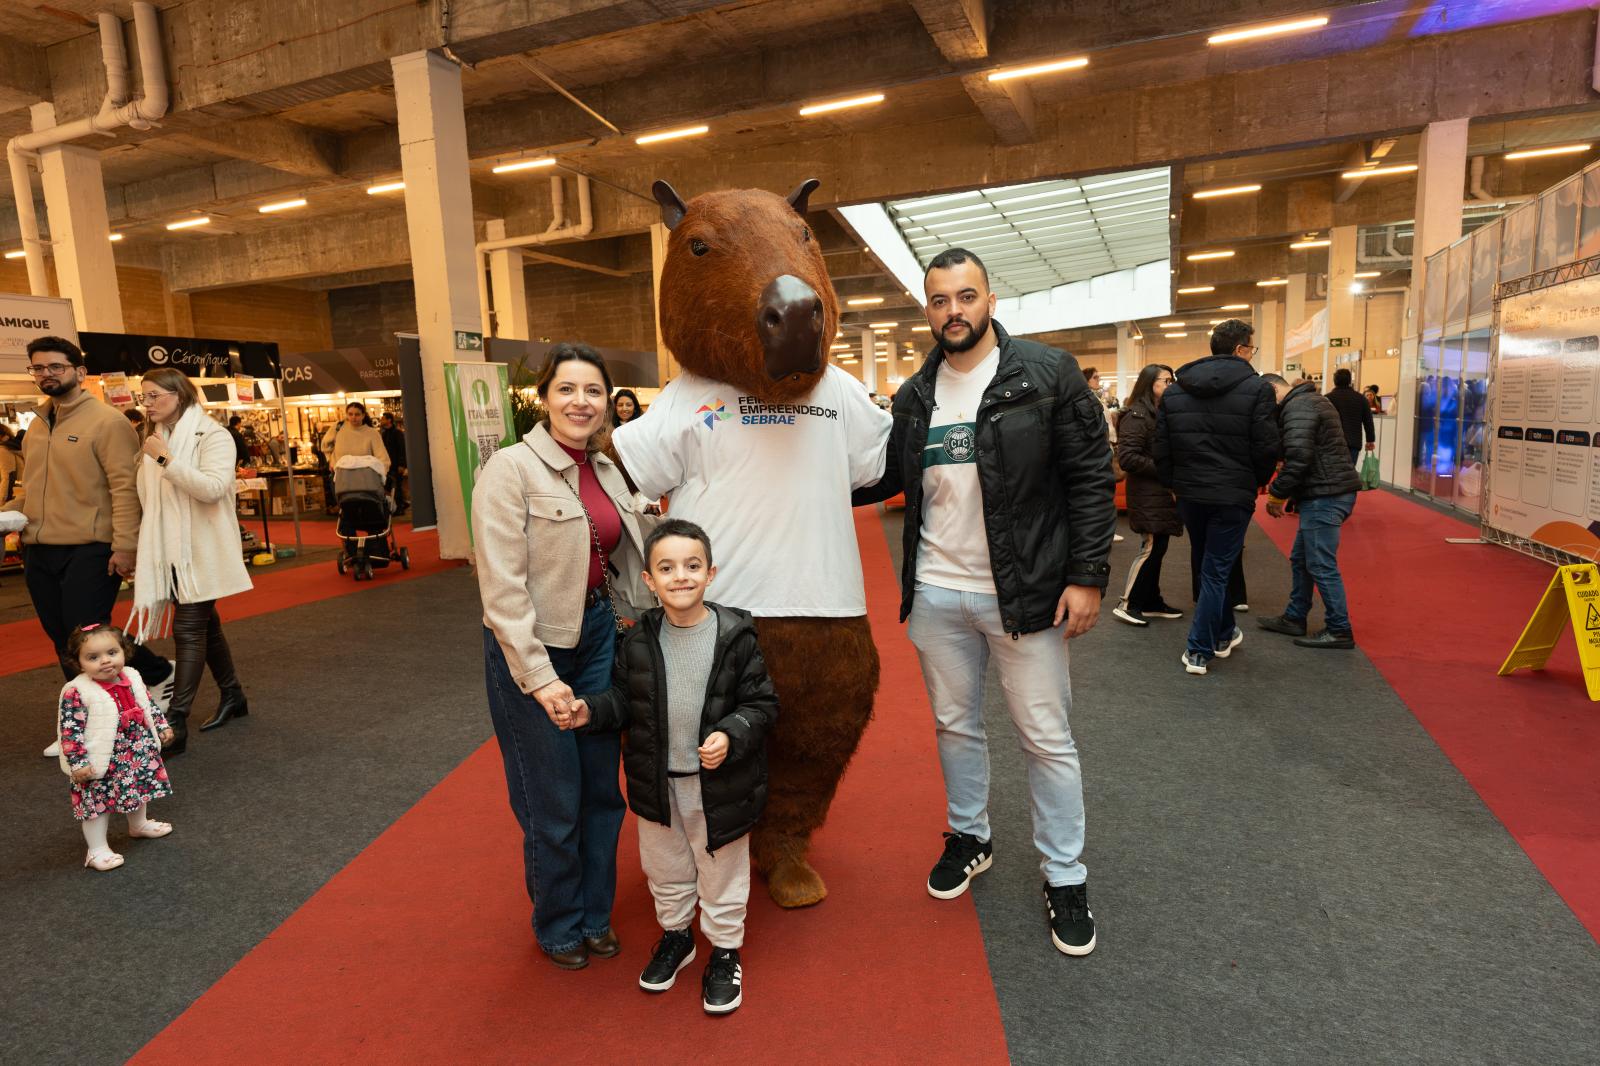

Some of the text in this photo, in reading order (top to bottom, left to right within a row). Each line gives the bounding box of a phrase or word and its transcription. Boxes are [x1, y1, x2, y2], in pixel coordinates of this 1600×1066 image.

[375, 358, 394, 368] LOJA
[360, 369, 395, 379] PARCEIRA
[739, 404, 838, 420] EMPREENDEDOR
[741, 415, 796, 425] SEBRAE
[1577, 590, 1599, 598] CUIDADO
